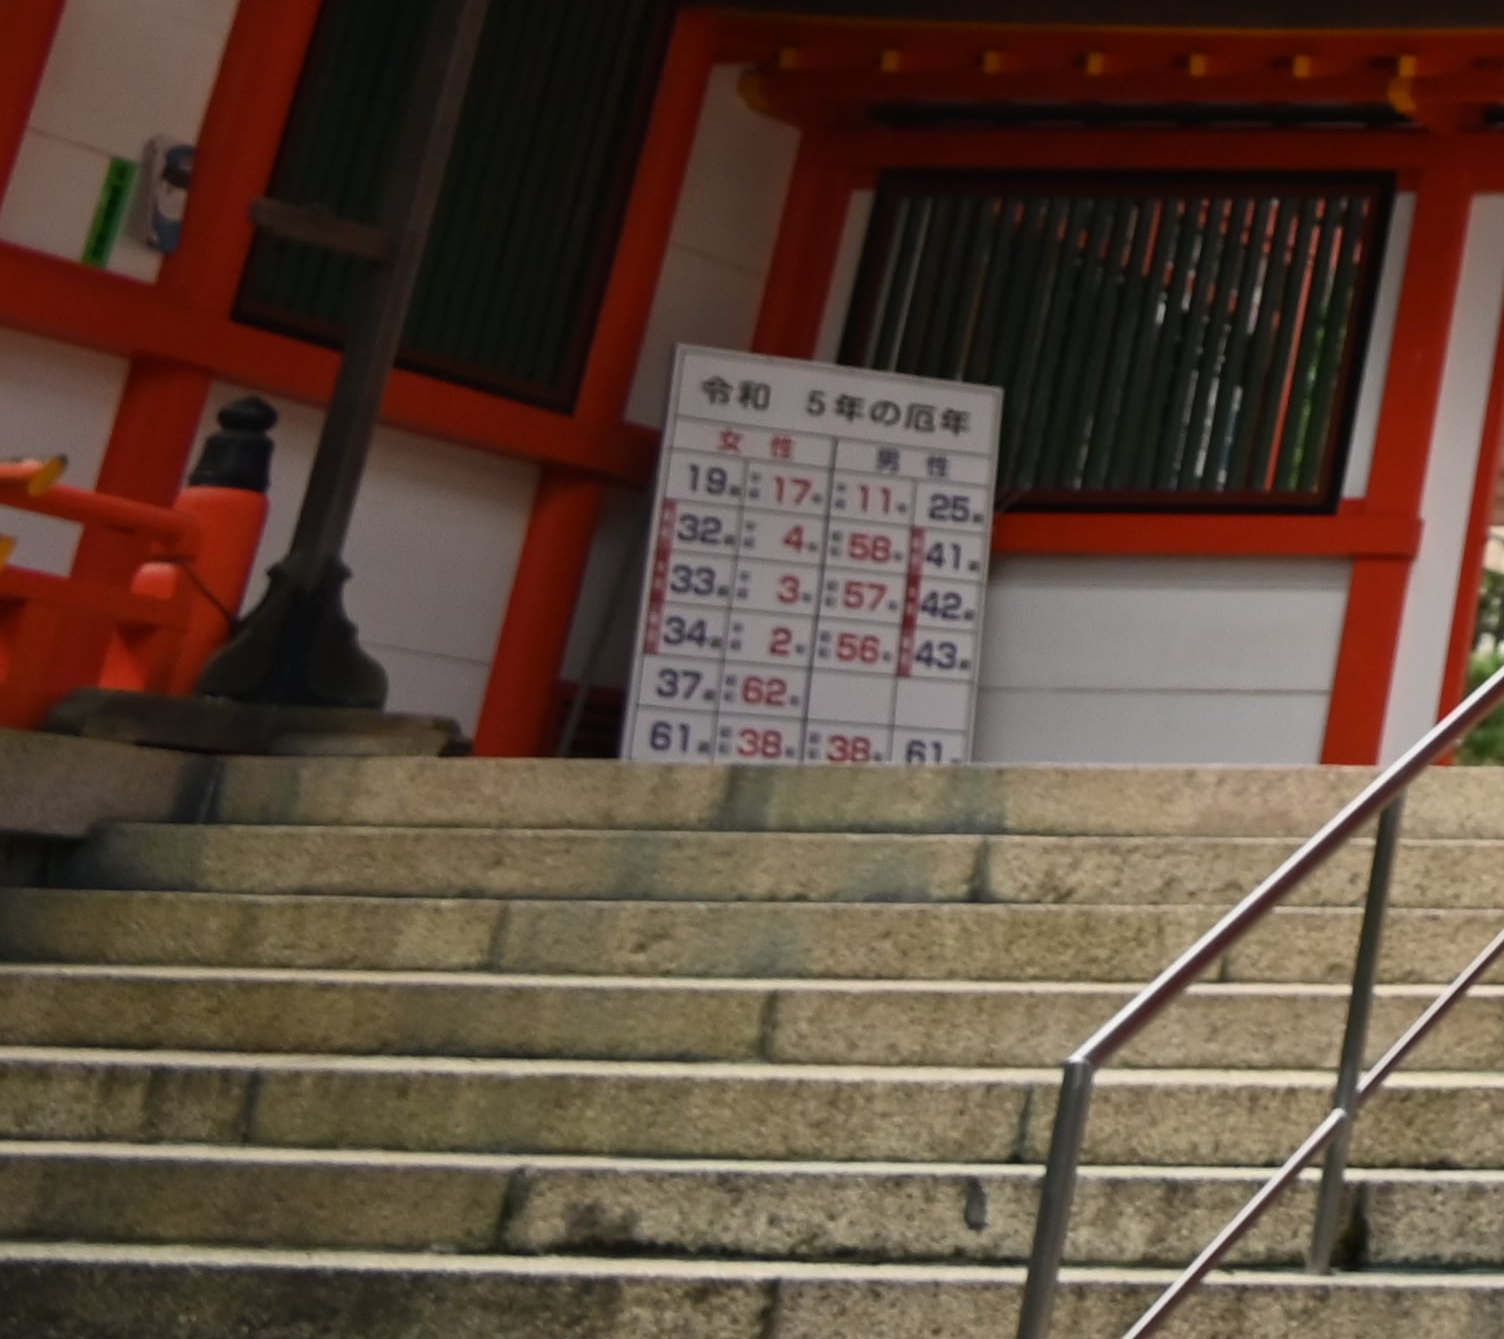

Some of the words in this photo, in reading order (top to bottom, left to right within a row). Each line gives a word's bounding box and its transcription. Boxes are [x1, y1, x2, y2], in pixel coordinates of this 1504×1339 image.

[702, 376, 771, 411] 令和
[806, 390, 971, 436] 5年の厄年
